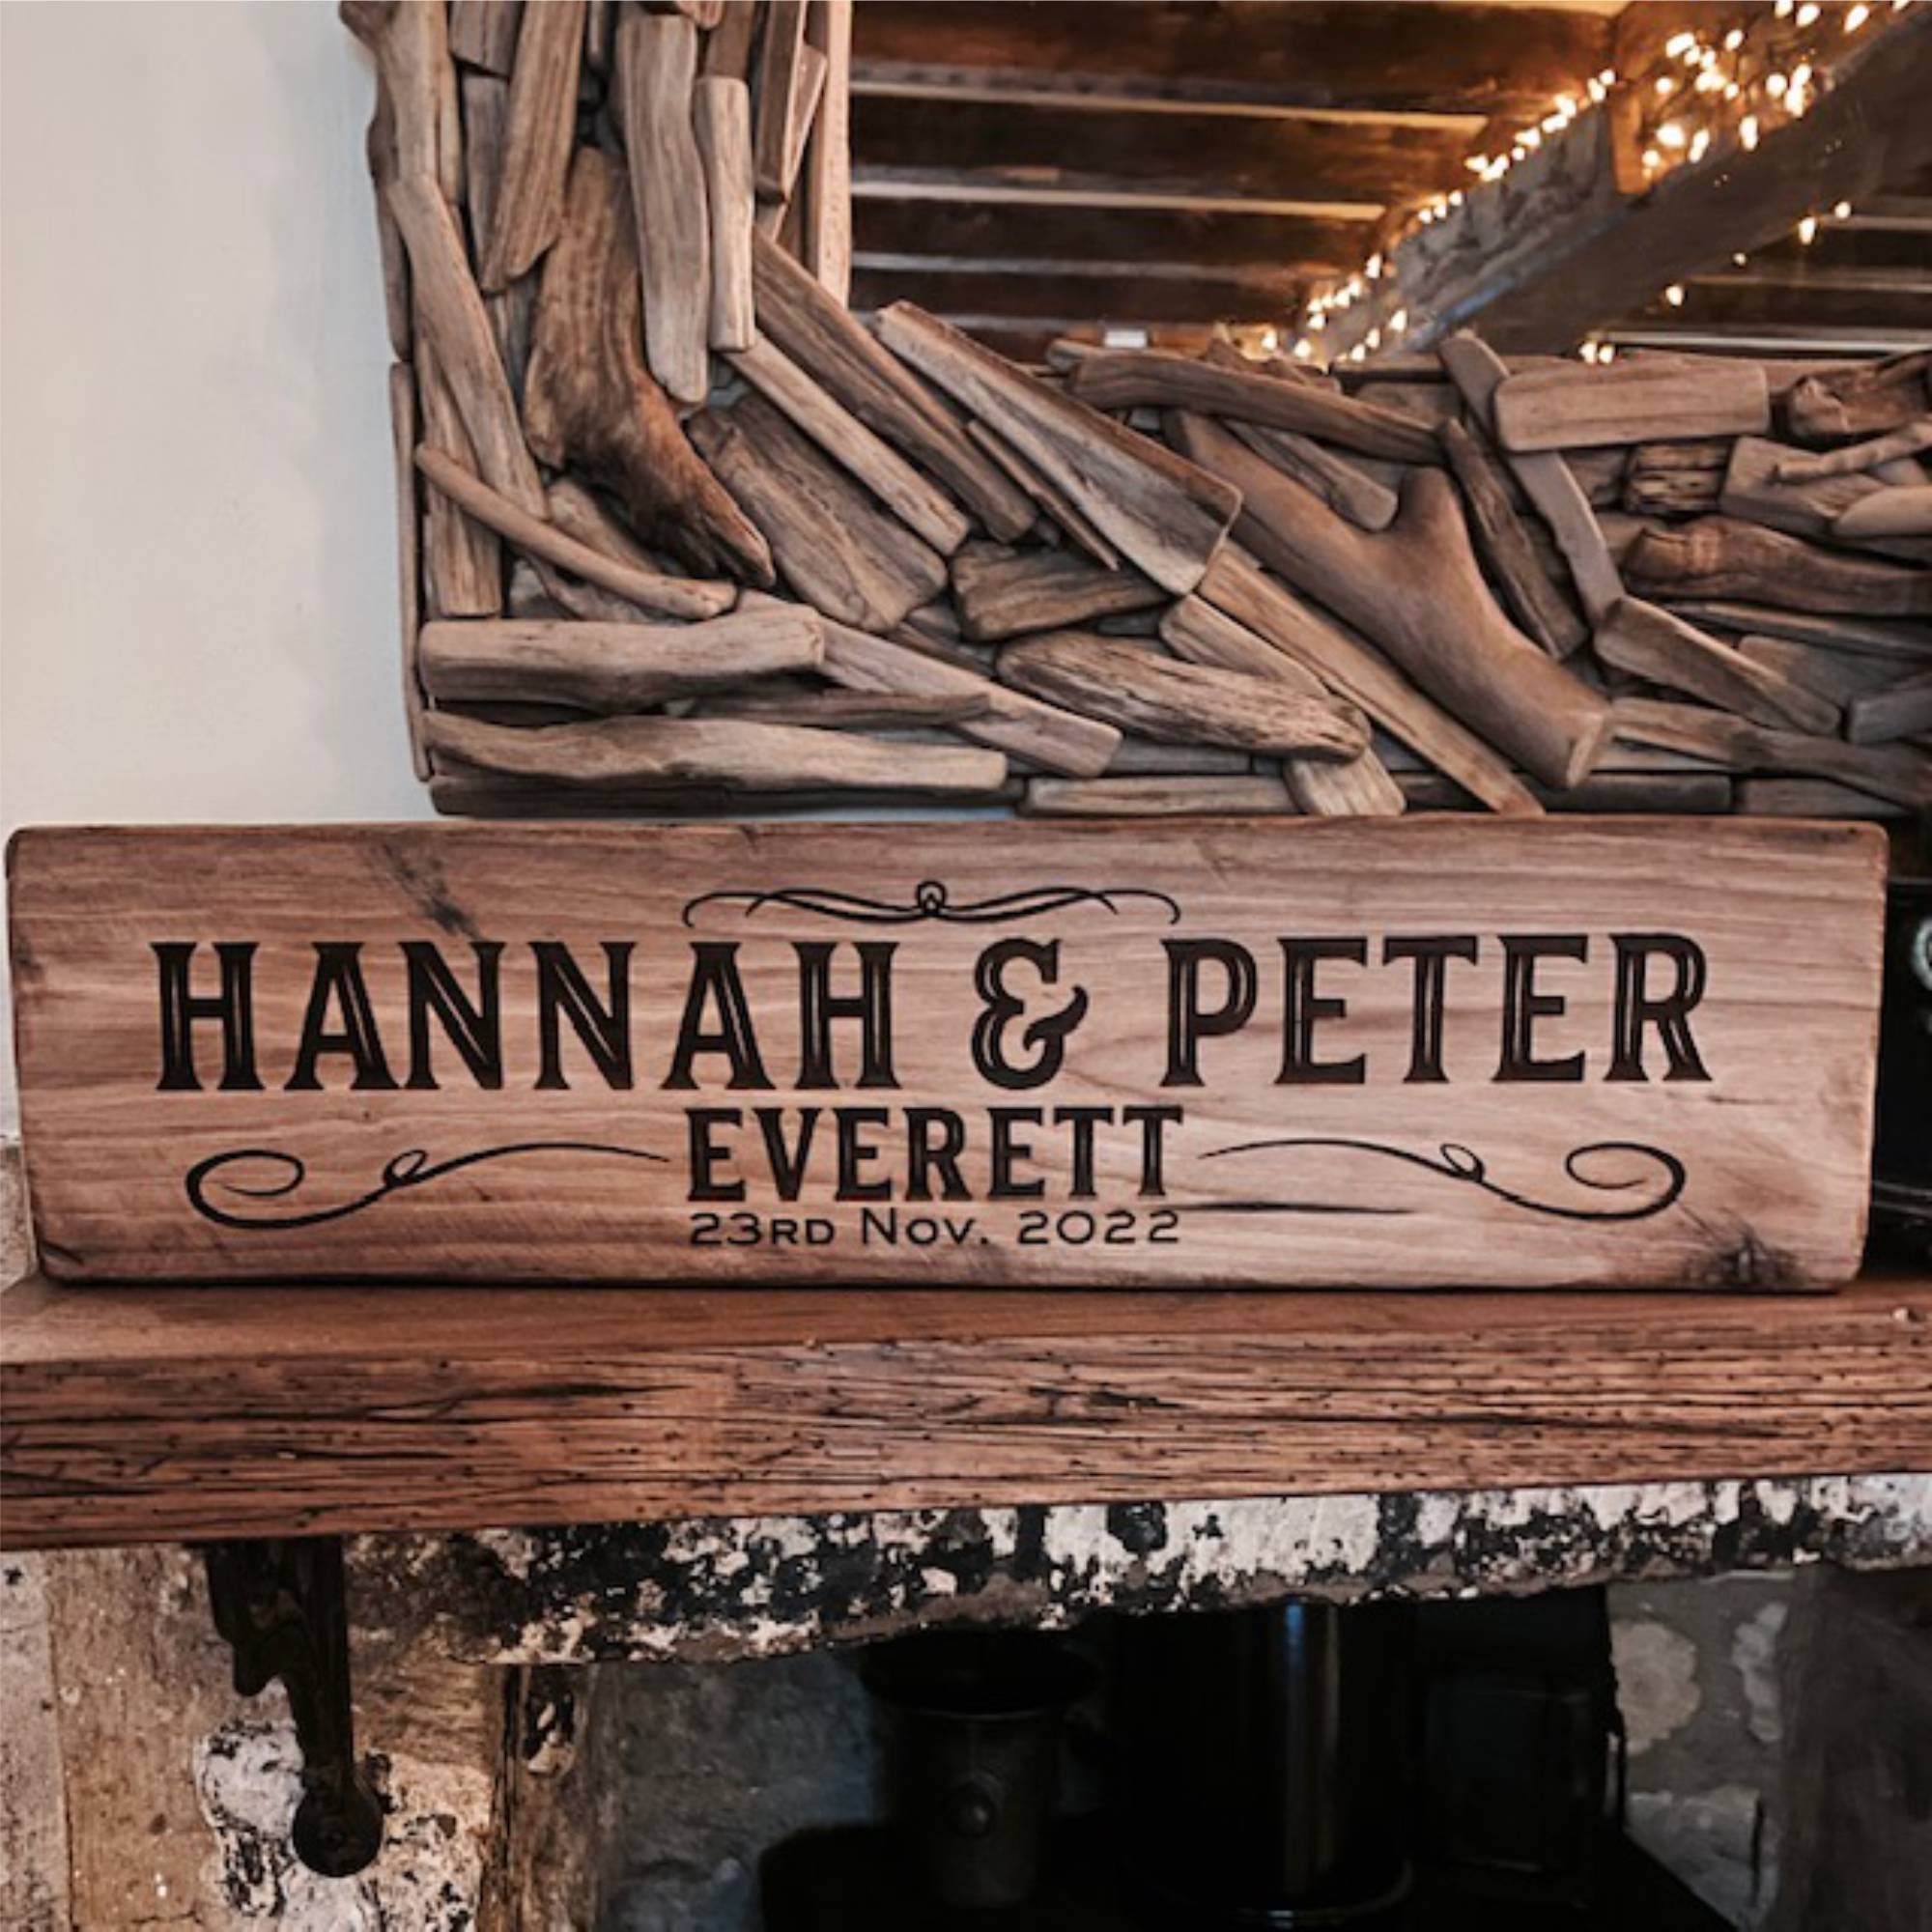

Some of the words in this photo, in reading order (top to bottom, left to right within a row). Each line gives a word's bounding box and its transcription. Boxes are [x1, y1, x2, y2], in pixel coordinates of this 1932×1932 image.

[150, 940, 902, 1092] HANNAH
[970, 936, 1089, 1092] &
[1159, 932, 1714, 1088] PETER
[684, 1105, 1184, 1203] EVERETT
[1017, 1209, 1180, 1245] 2022
